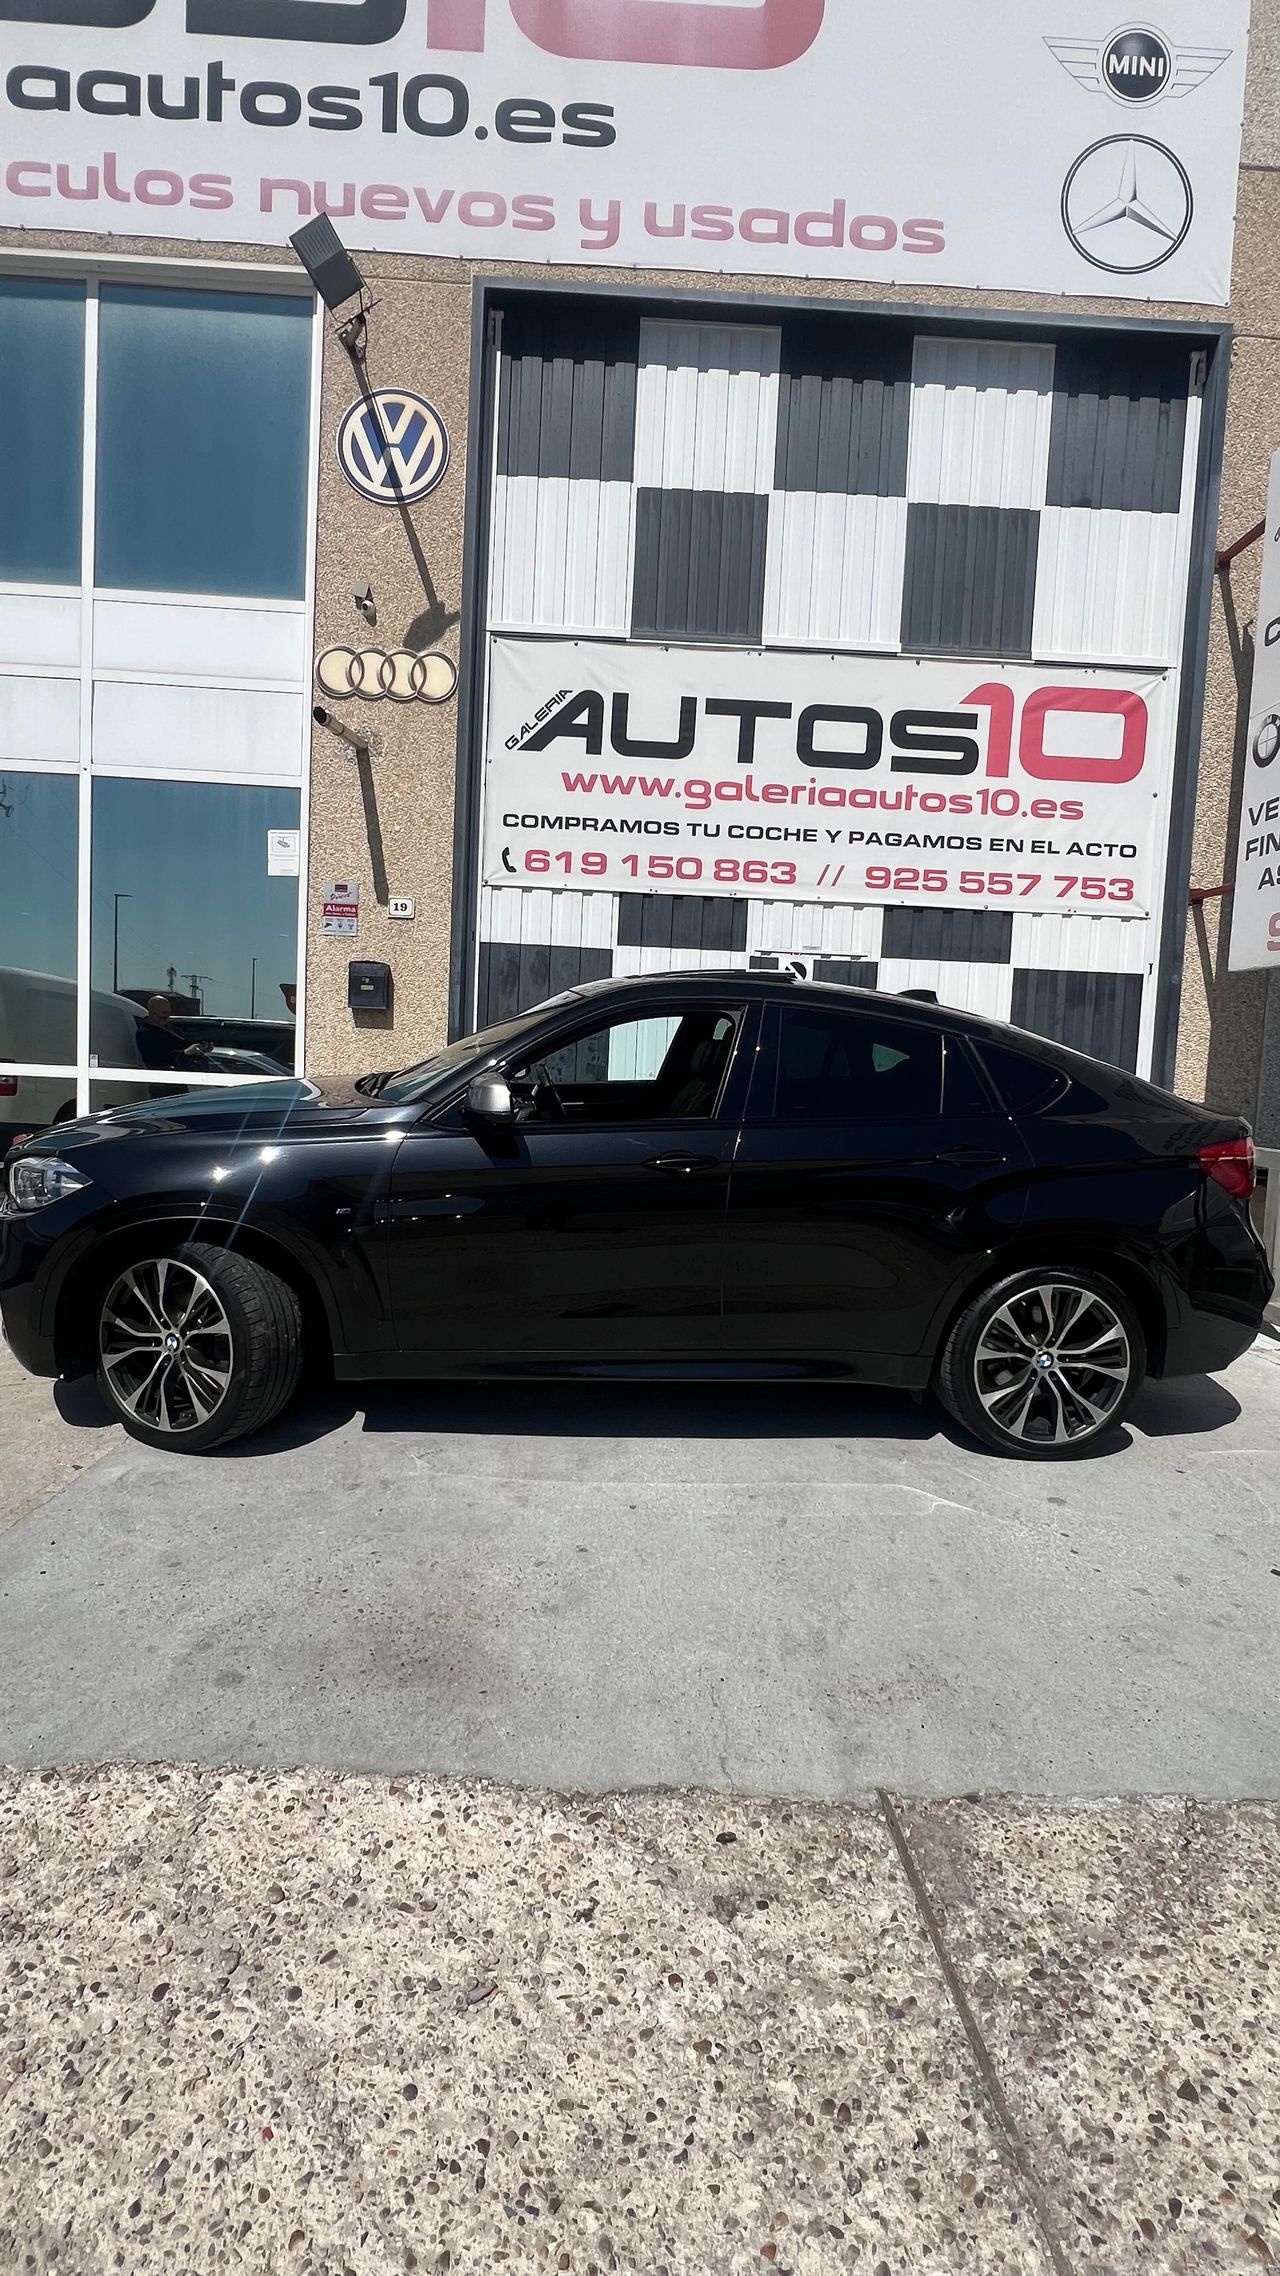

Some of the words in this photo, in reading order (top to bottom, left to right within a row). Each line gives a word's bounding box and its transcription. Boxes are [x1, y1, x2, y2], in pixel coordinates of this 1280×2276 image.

[1109, 54, 1164, 77] MINI
[5, 60, 617, 148] aautos10.es
[5, 152, 234, 211] culos
[259, 176, 556, 232] nuevos
[578, 198, 622, 250] y
[645, 198, 946, 254] usados
[504, 689, 574, 751] GALERIA
[516, 682, 1149, 785] AUTOS10
[560, 771, 1085, 822] www.galeriaautos10.es
[502, 813, 680, 836] COMPRAMOS
[686, 822, 722, 839] TU
[727, 824, 819, 843] COCHE
[824, 829, 843, 844] Y
[848, 830, 982, 851] PAGAMOS
[989, 837, 1024, 854] EN
[1030, 840, 1062, 856] EL
[1065, 841, 1138, 860] ACTO
[524, 849, 608, 877] 619
[621, 854, 703, 882] 150
[713, 859, 797, 886] 863
[864, 865, 948, 893] 925
[959, 870, 1043, 897] 557
[1054, 874, 1135, 902] 753
[326, 904, 356, 913] Alarma
[393, 902, 408, 912] 19
